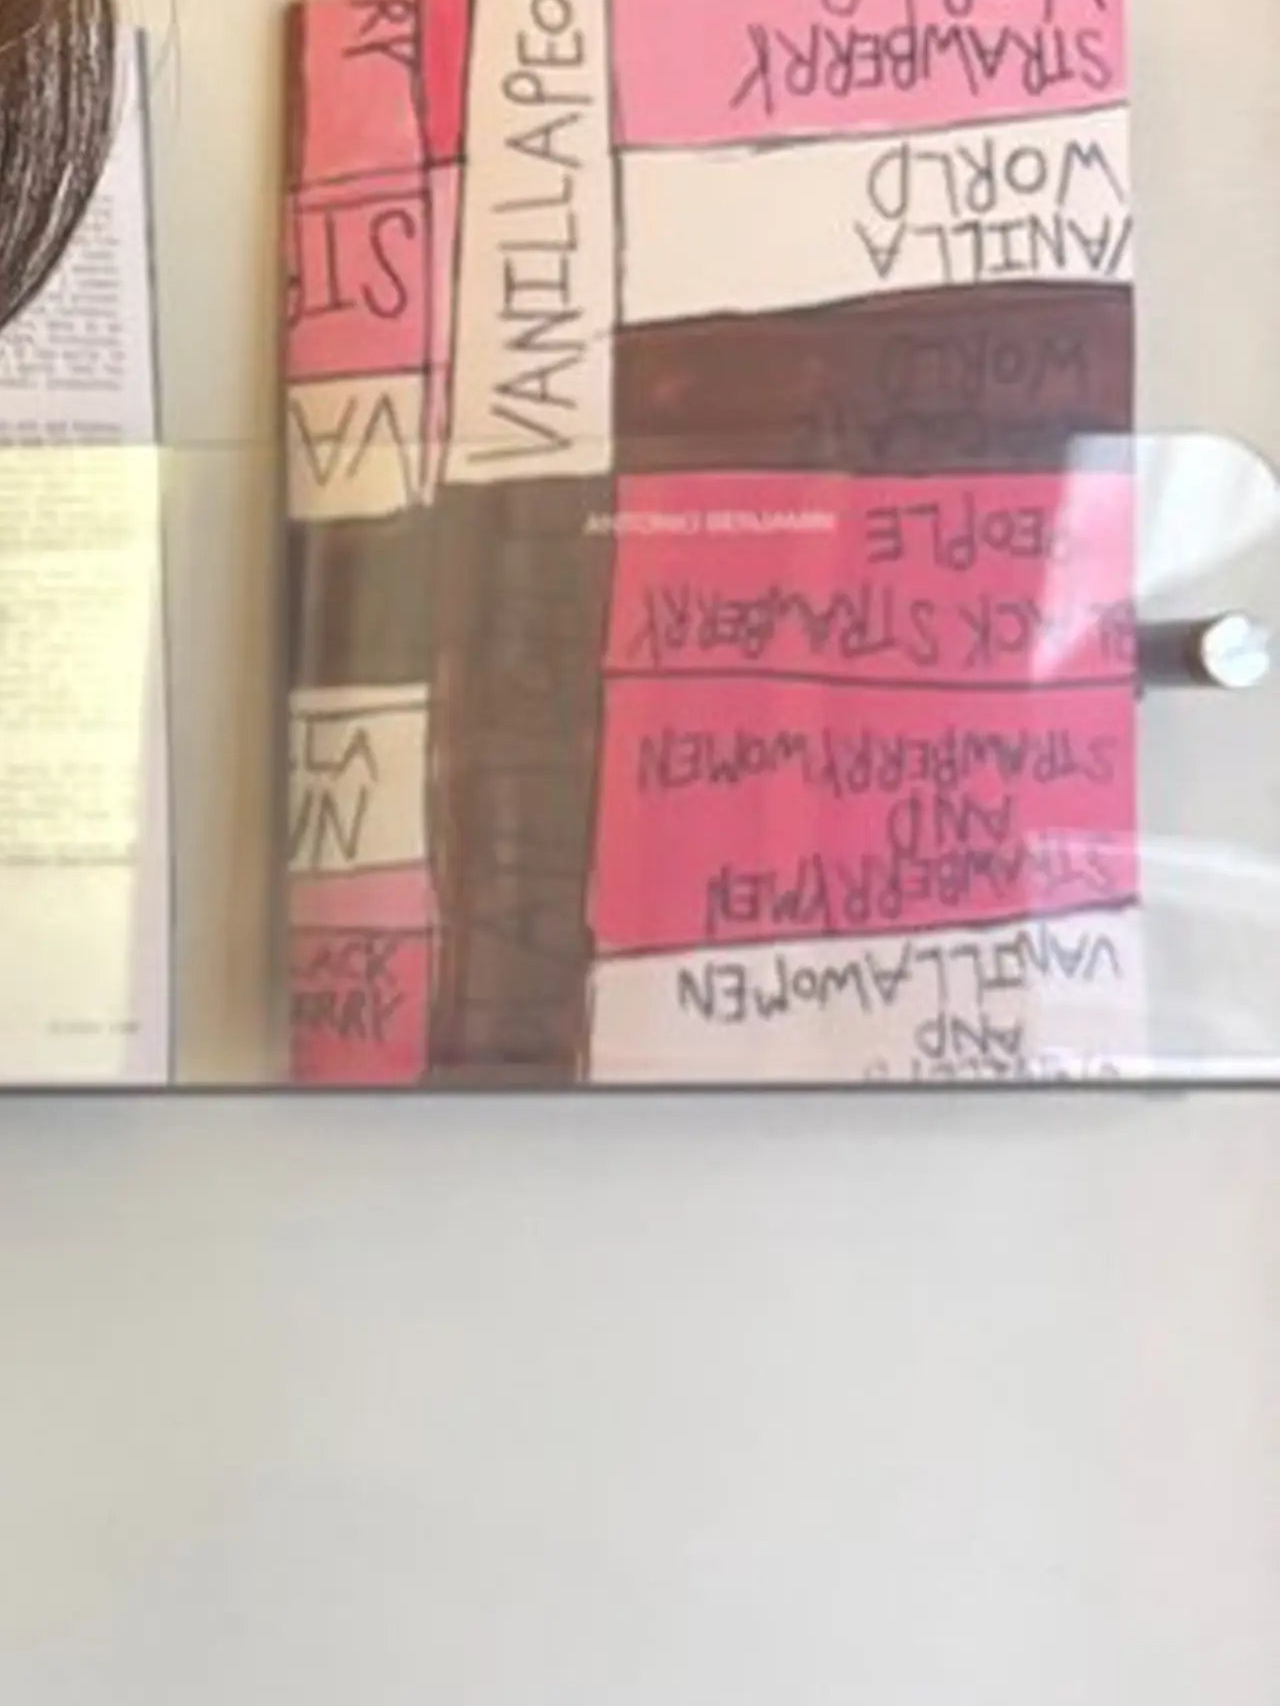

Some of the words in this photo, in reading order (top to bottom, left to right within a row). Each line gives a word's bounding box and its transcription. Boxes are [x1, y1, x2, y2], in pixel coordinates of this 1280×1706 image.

[867, 138, 1126, 220] WORLD
[887, 794, 1014, 859] AND
[914, 1012, 1025, 1058] AND
